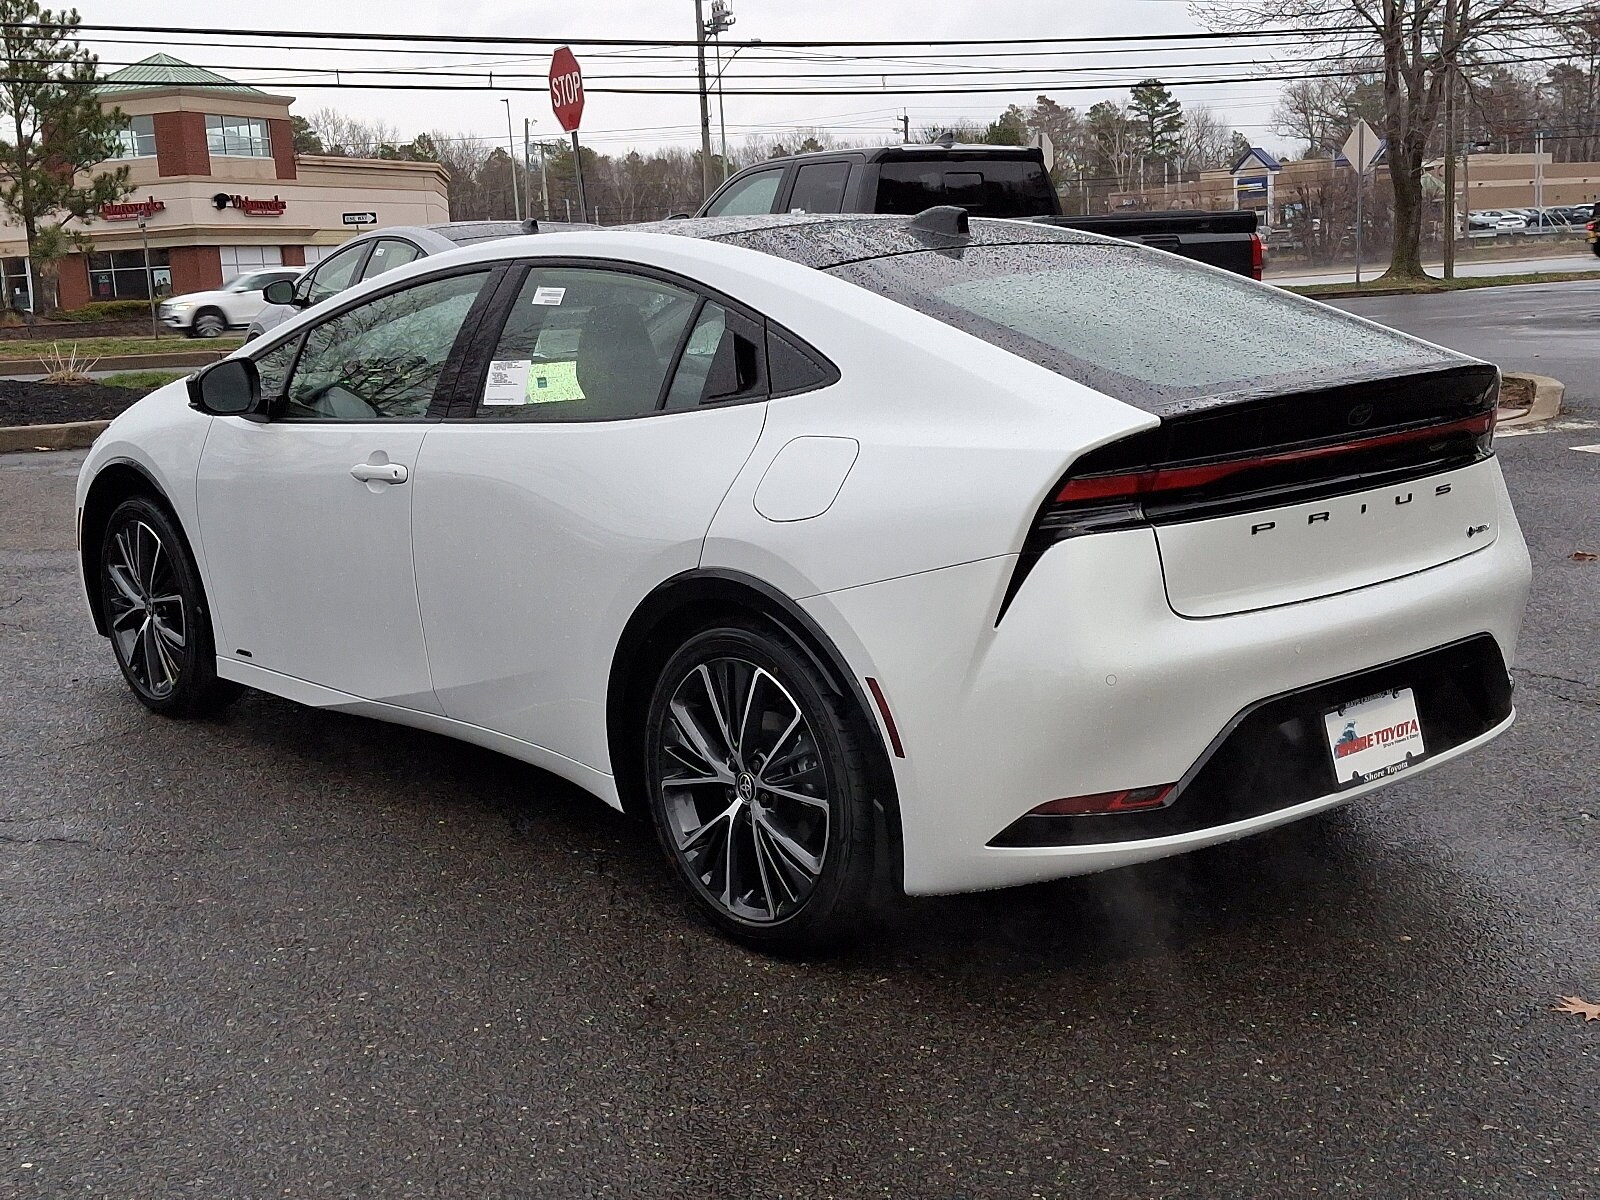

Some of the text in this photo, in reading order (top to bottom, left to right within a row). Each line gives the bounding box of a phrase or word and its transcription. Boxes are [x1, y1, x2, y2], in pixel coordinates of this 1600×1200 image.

[552, 71, 580, 108] STOP
[1251, 483, 1452, 535] PRIUS
[1374, 719, 1418, 745] TOYOTA
[1363, 761, 1408, 782] Shore Toyota
